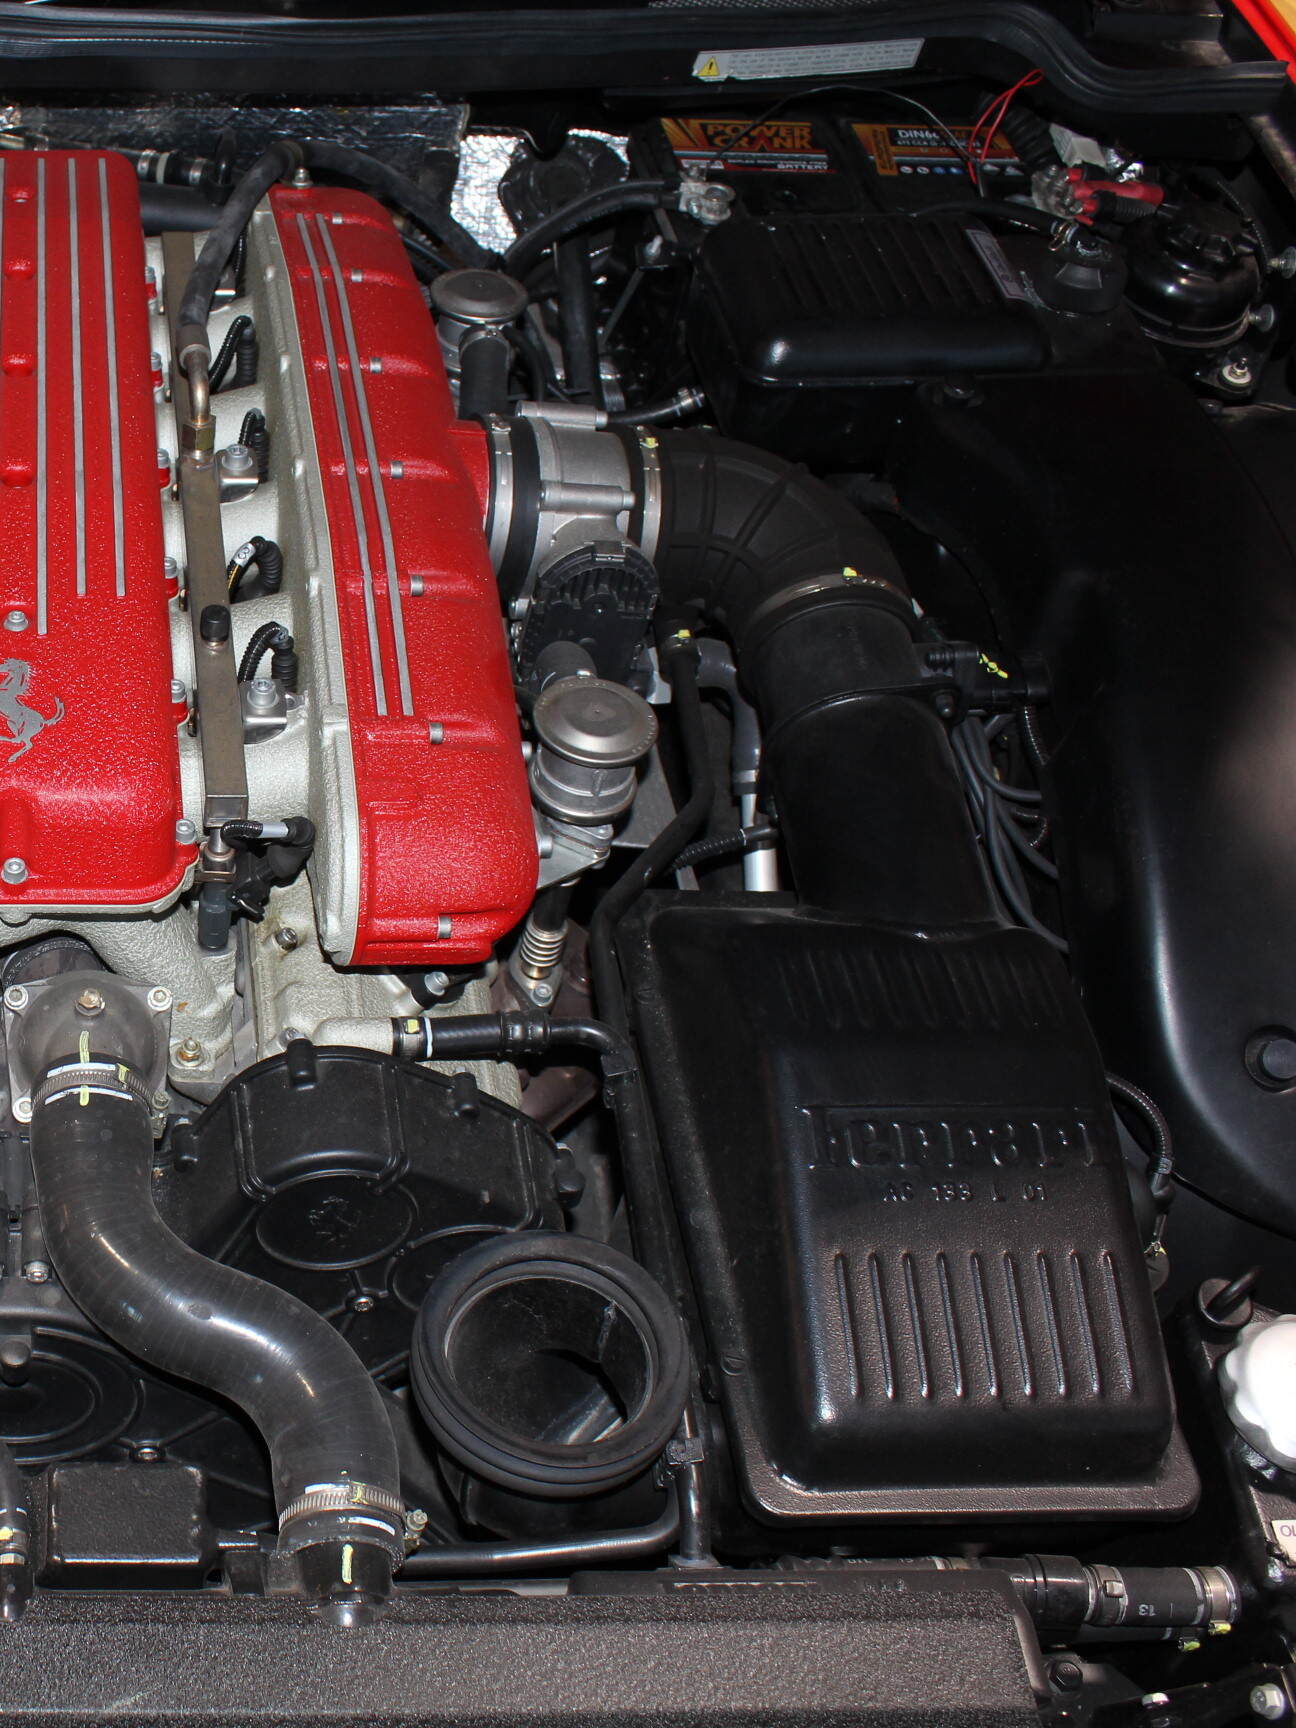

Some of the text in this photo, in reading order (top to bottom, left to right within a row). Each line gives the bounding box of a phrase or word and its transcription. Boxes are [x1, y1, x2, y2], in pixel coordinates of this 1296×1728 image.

[706, 124, 812, 137] POWER
[798, 1105, 1099, 1170] Ferrari
[930, 1182, 974, 1202] 133
[1138, 1604, 1157, 1617] 13
